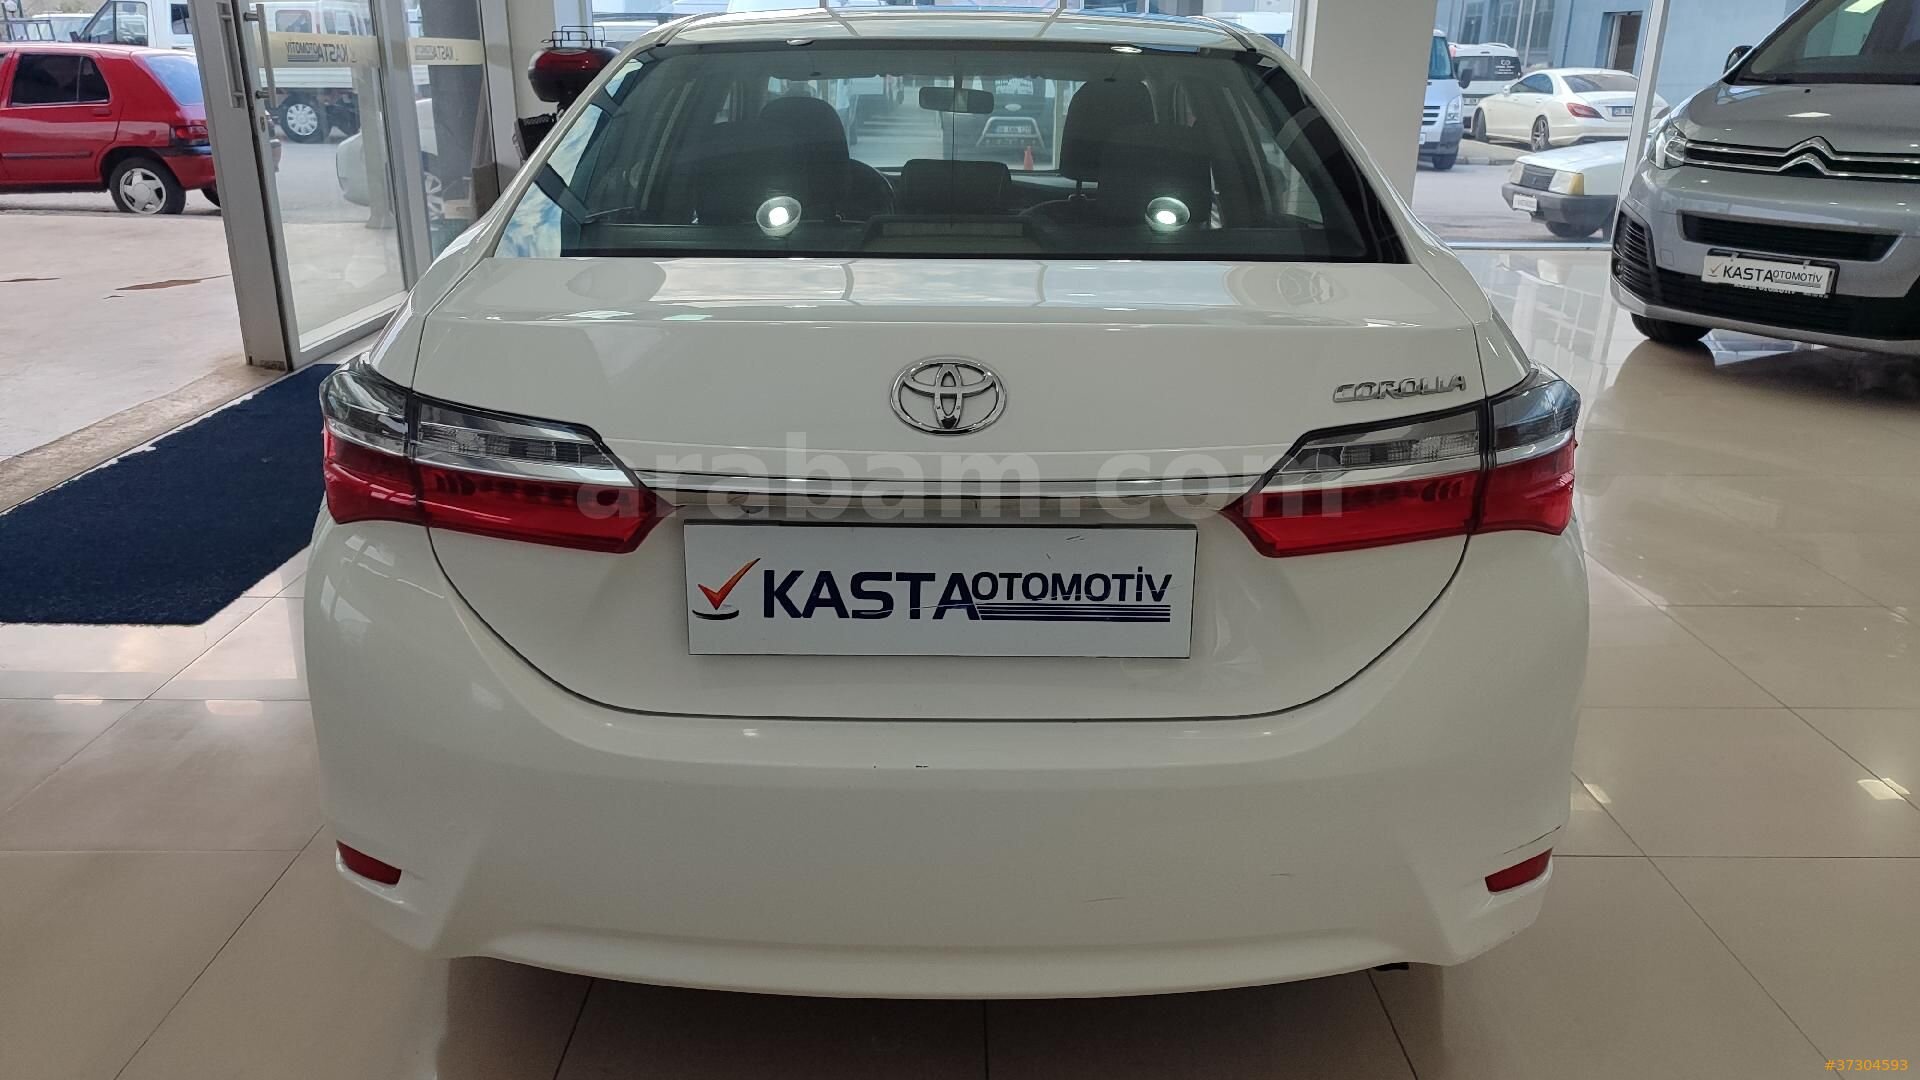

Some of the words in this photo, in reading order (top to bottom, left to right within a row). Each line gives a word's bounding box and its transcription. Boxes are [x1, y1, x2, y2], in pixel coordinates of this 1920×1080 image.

[1723, 265, 1774, 282] KASTA
[1333, 375, 1466, 403] COROLLA
[764, 570, 980, 620] KASTA
